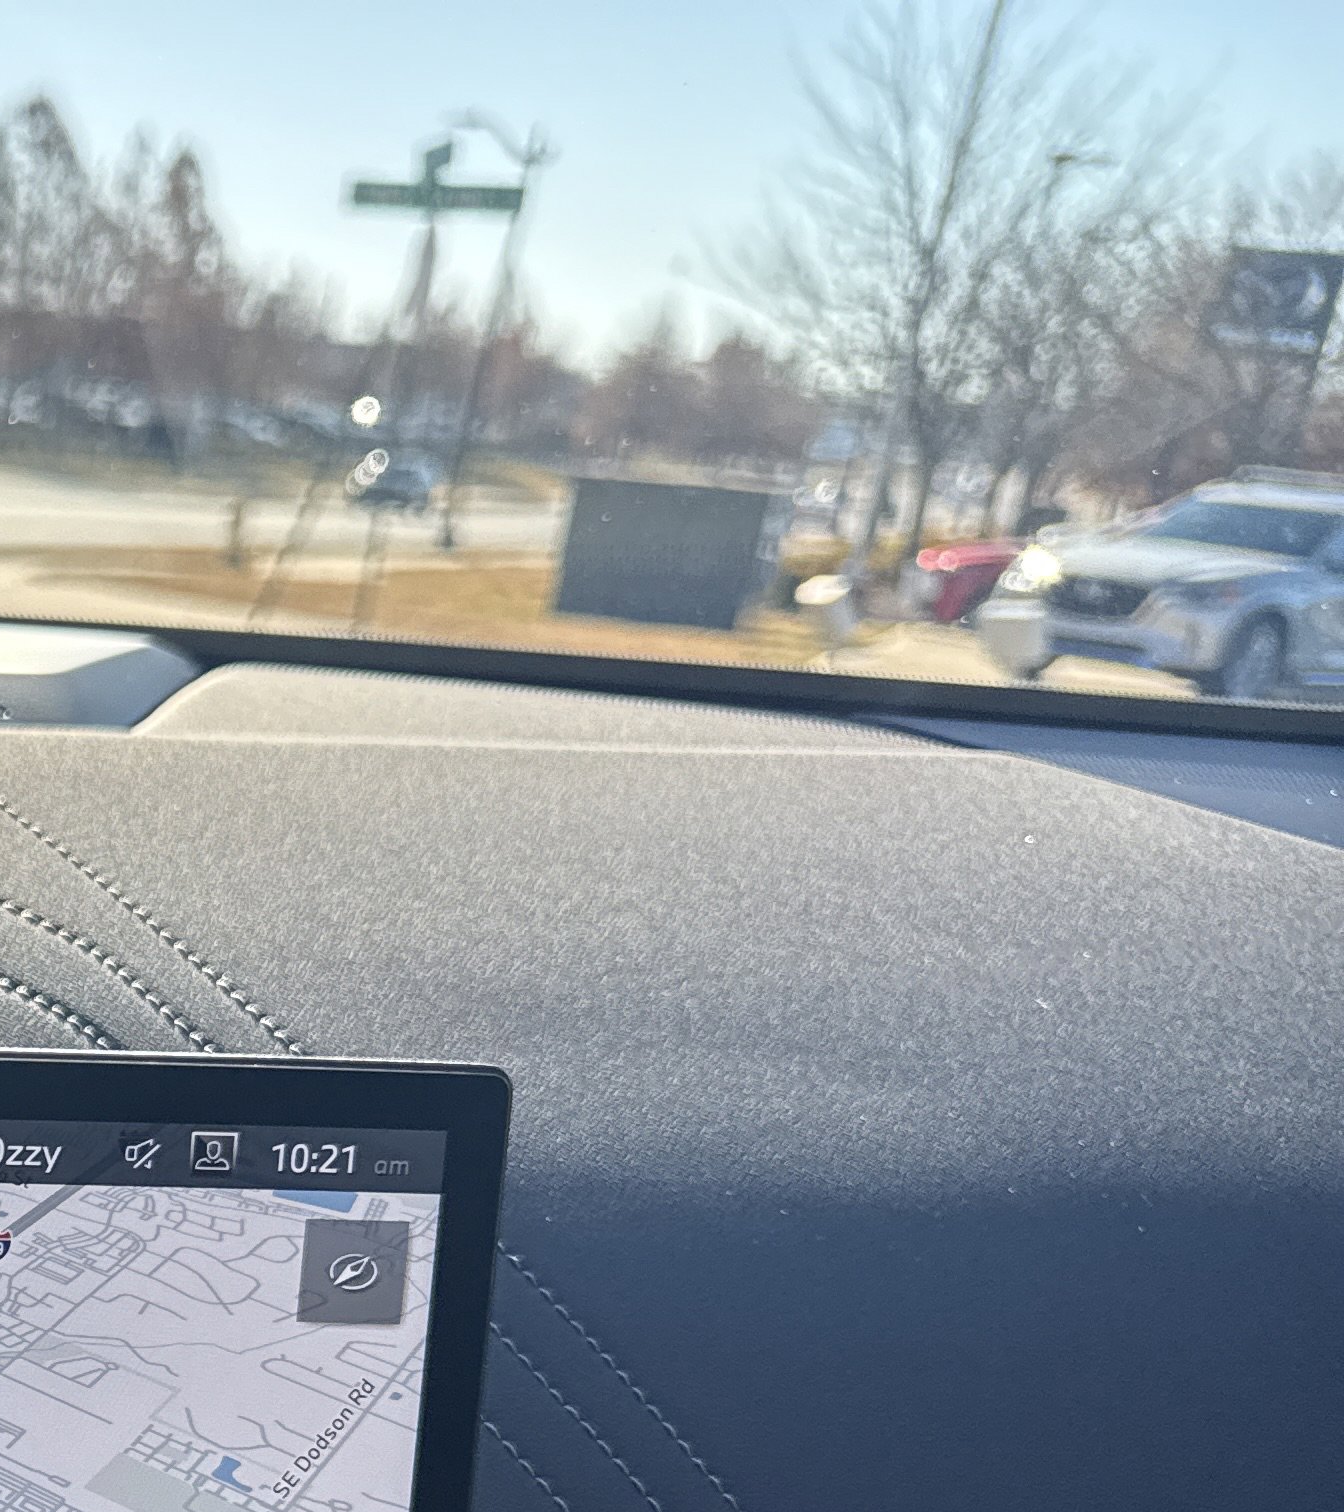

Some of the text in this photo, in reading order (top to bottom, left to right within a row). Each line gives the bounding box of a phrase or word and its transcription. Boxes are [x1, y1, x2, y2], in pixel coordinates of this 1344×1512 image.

[271, 1143, 409, 1175] 10:21 am
[272, 1378, 376, 1499] SE Dodson Rd
